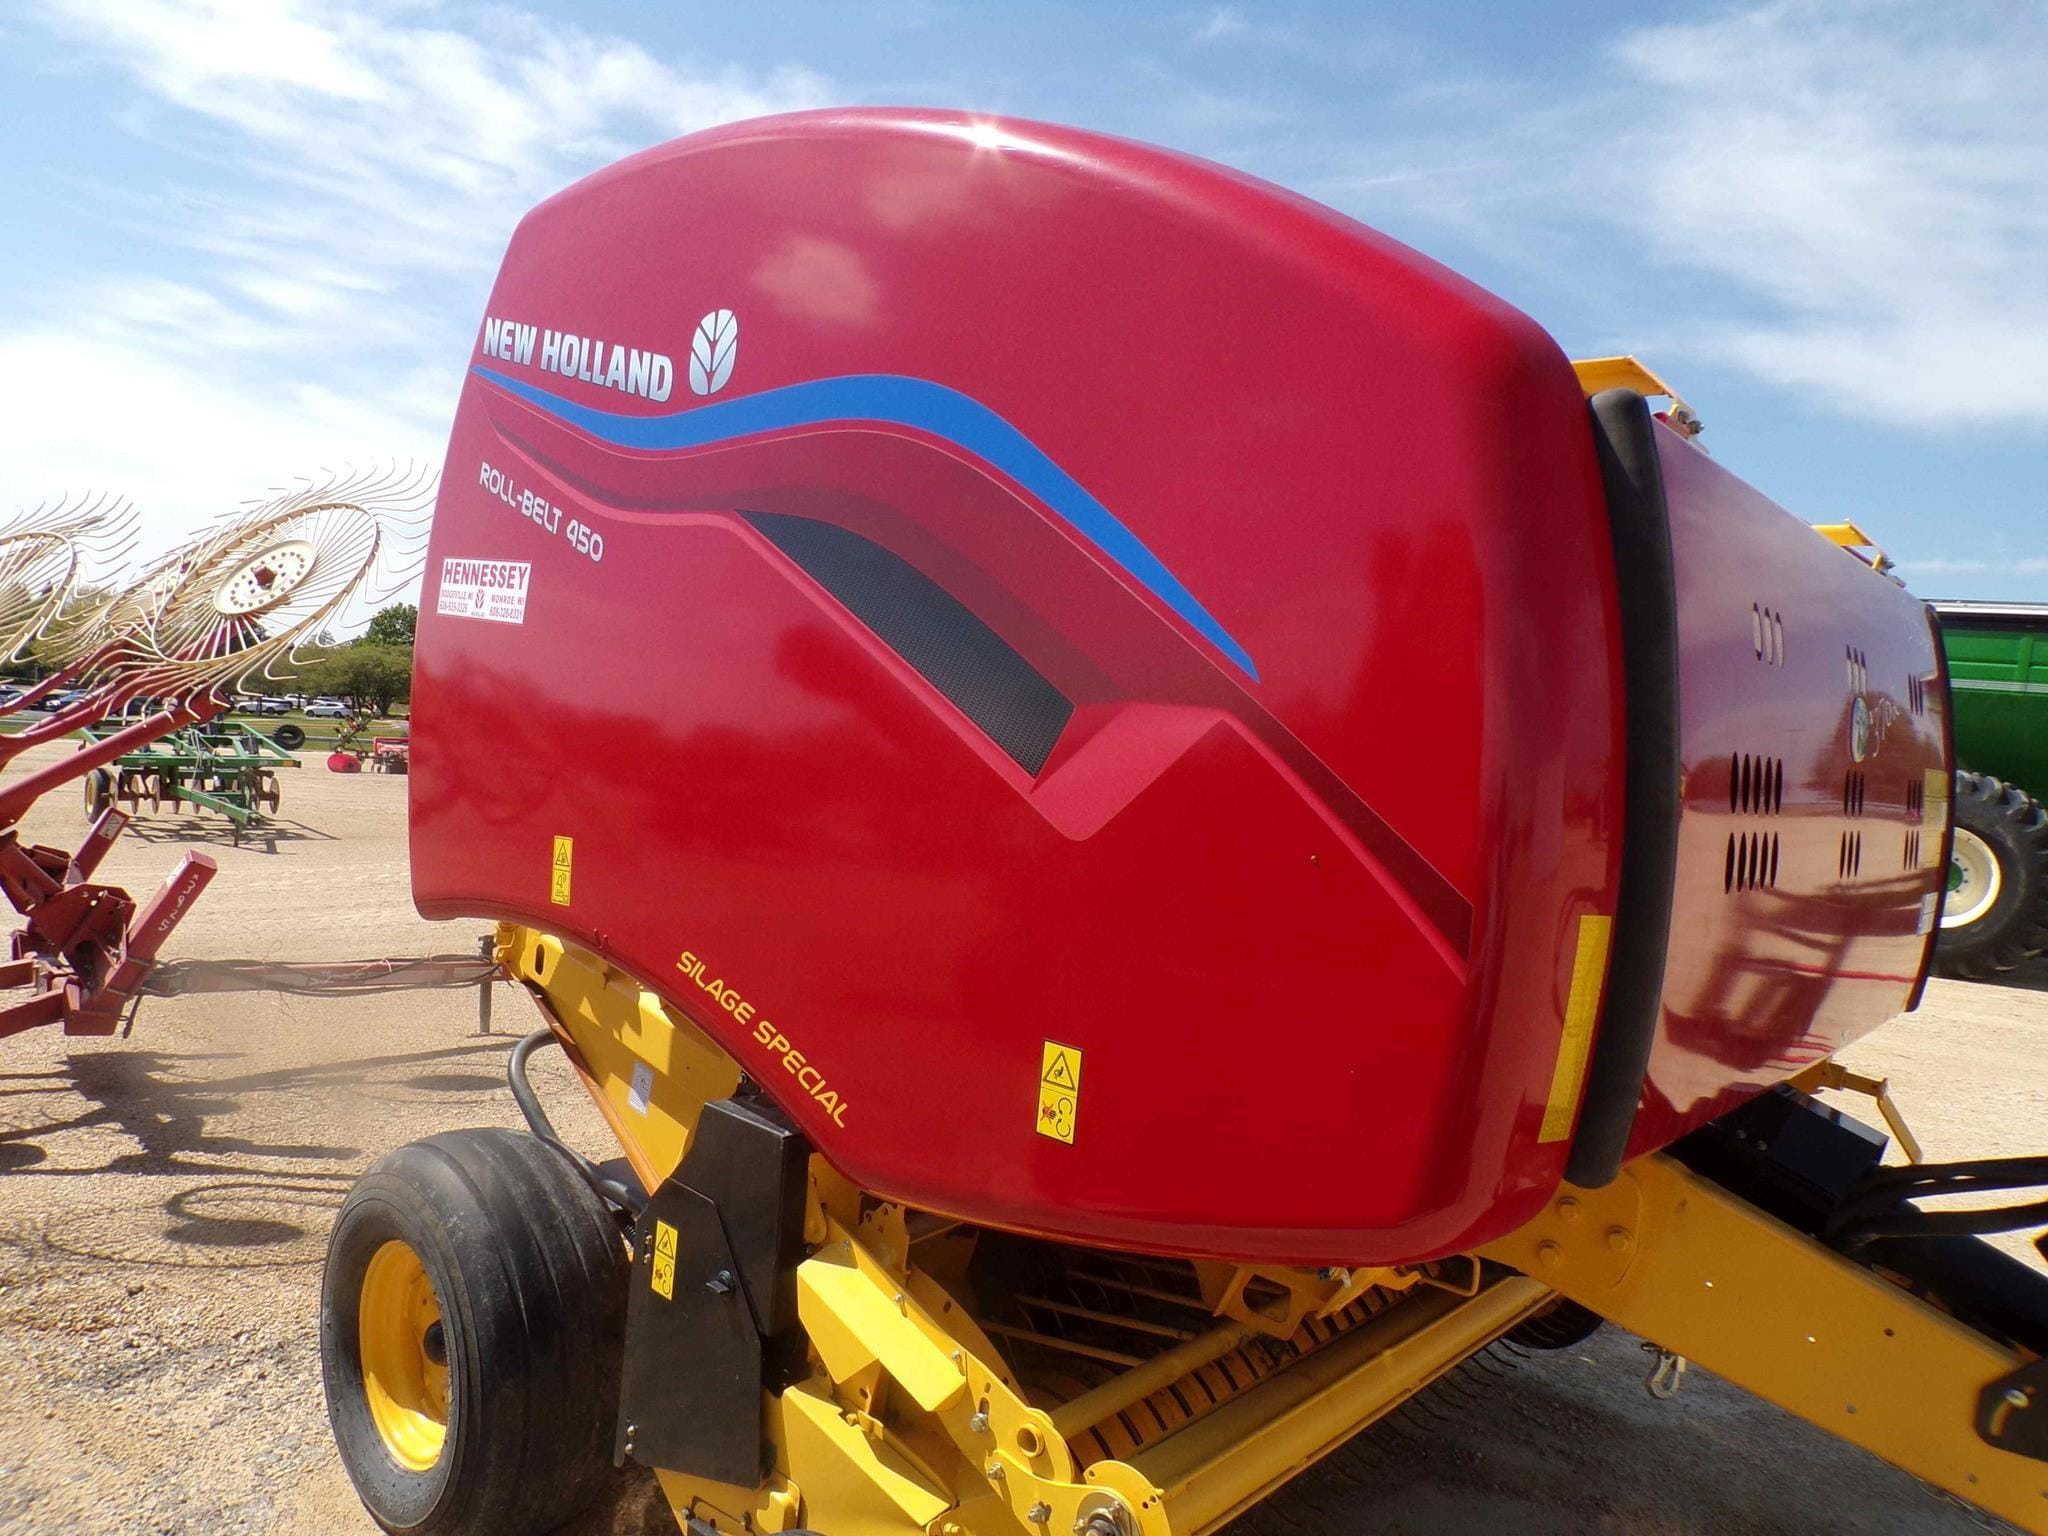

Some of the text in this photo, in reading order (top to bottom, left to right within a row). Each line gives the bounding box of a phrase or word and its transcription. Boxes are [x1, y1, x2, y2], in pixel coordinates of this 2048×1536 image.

[483, 317, 674, 403] NEW HOLLAND
[479, 461, 604, 562] ROLL-BELT 450
[443, 561, 528, 590] HENNESSEY
[676, 951, 848, 1129] SILAGE SPECIAL
